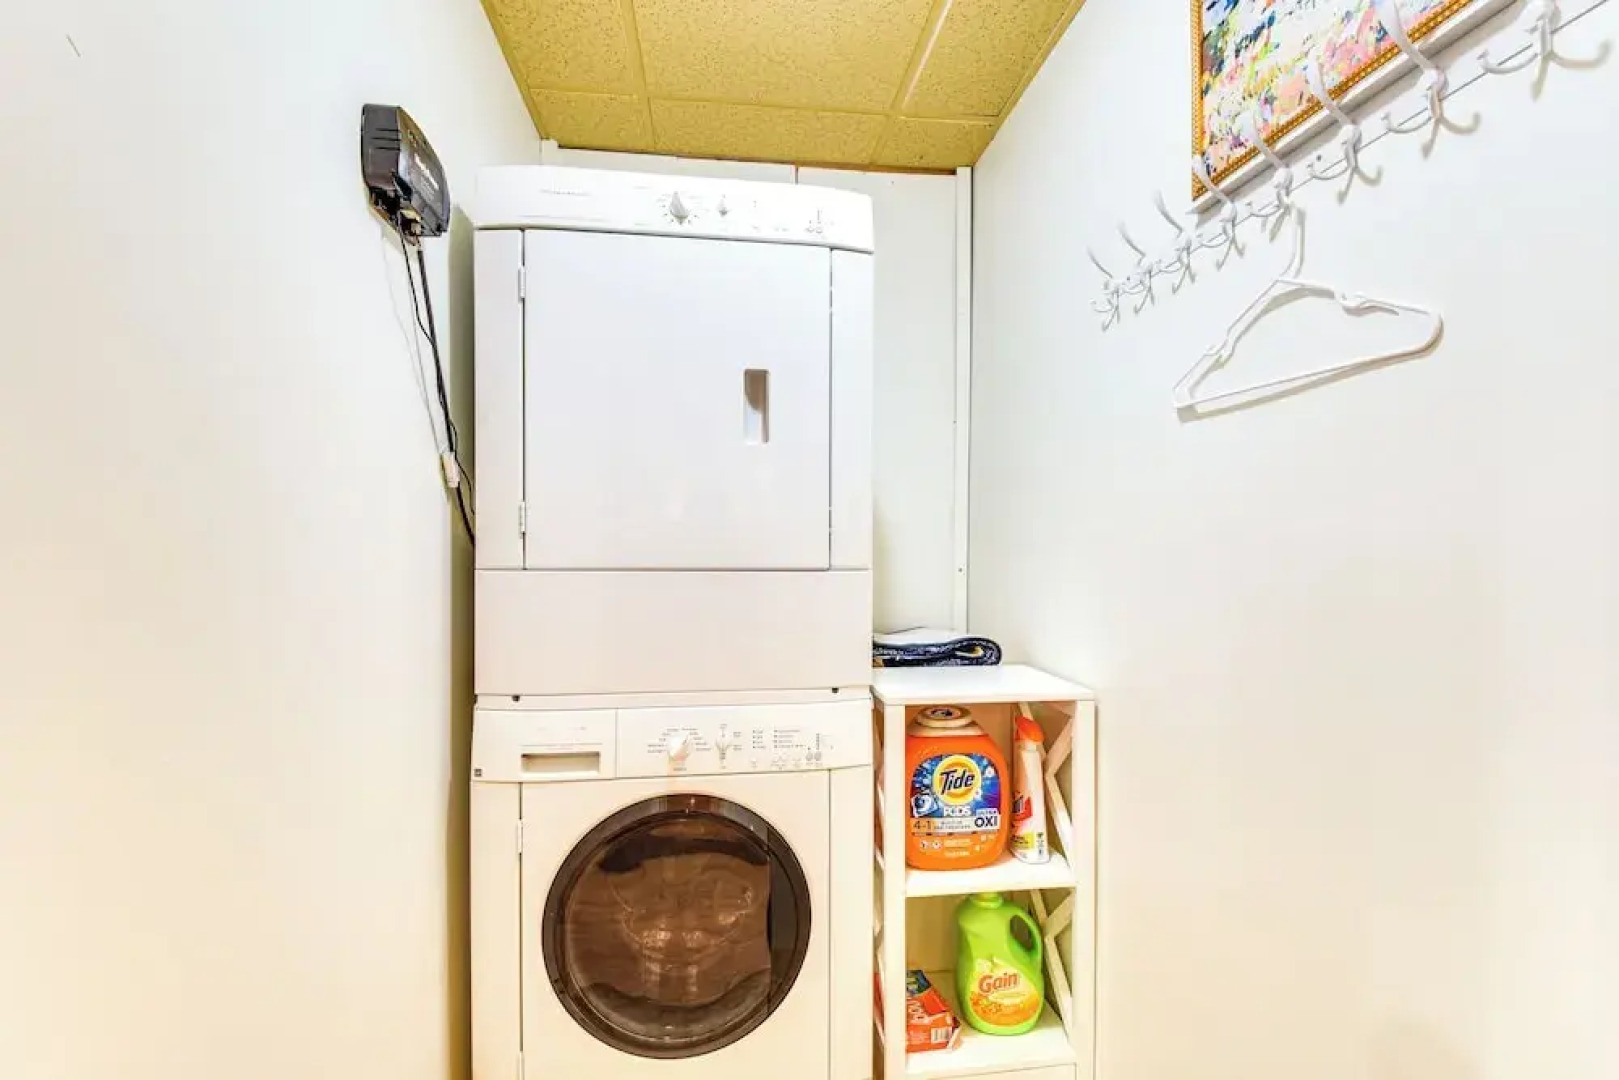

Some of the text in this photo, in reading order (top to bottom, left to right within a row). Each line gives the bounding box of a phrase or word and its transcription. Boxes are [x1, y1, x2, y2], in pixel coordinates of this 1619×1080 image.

[940, 769, 975, 795] Tide
[974, 816, 998, 828] OXI
[979, 972, 1018, 992] Gain
